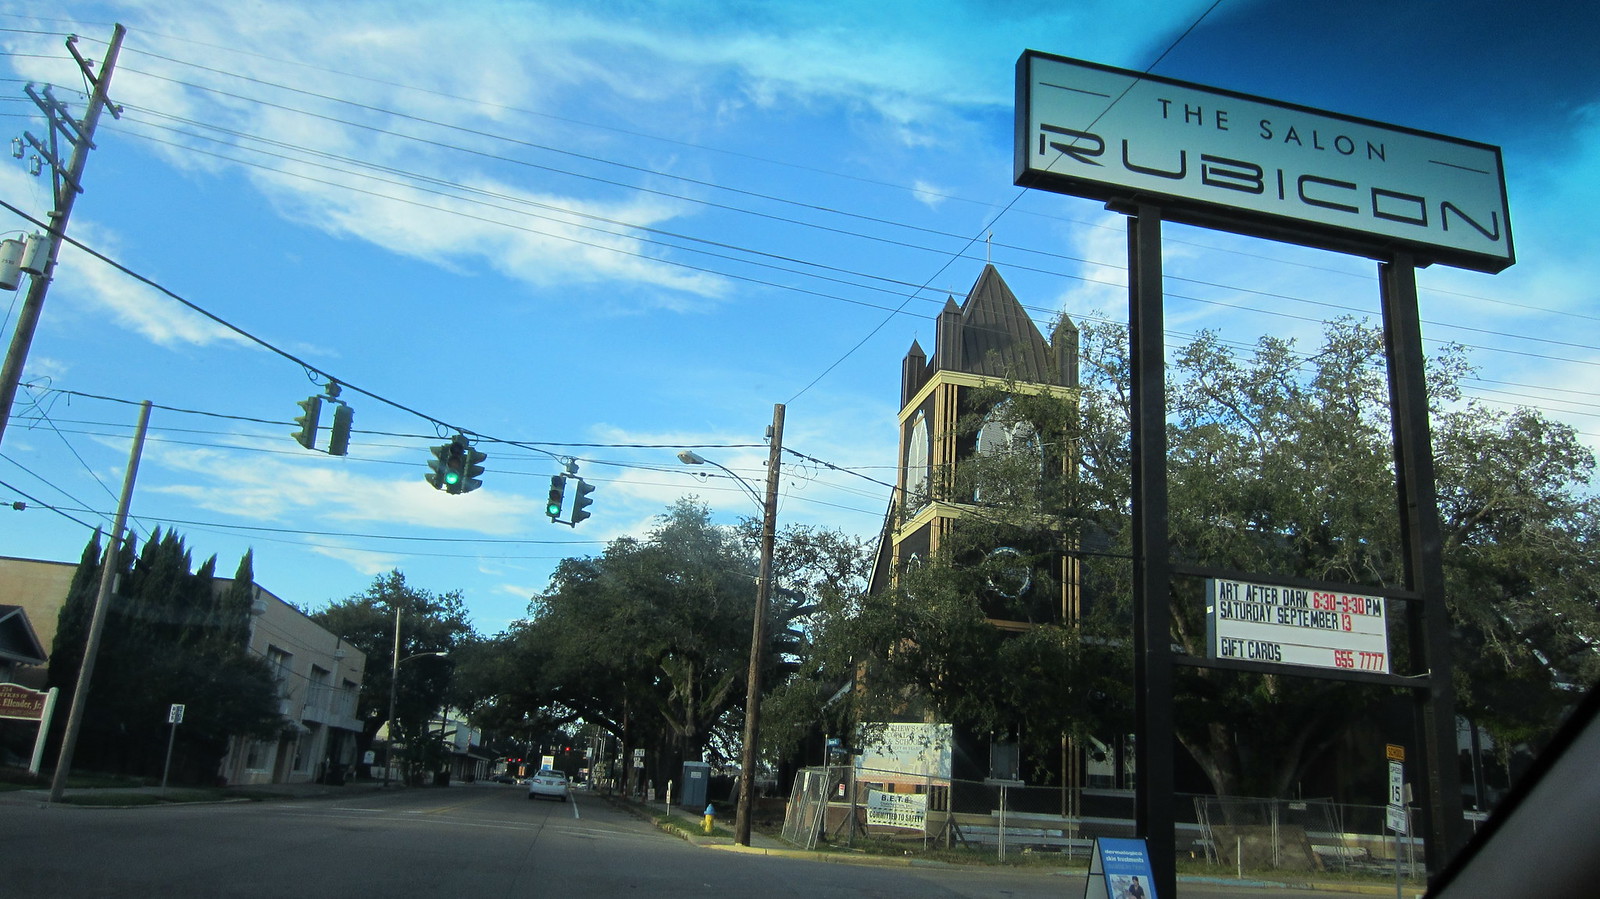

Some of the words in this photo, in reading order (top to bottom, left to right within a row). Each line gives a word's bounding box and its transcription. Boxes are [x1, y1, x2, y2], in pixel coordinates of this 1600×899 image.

[1157, 98, 1230, 131] THE
[1259, 118, 1386, 163] SALON
[1038, 122, 1501, 242] RUBICON
[1219, 581, 1240, 601] ART
[1245, 584, 1278, 605] AFTER
[1282, 589, 1309, 608] DARK
[1219, 601, 1272, 623] SATURDAY
[1277, 607, 1339, 630] SEPTEMBER
[1341, 613, 1352, 631] 13
[1221, 638, 1244, 658] GIFT
[1247, 641, 1282, 662] CARDS
[1334, 650, 1354, 668] 655
[1359, 652, 1385, 671] 7777
[1391, 785, 1401, 802] 15
[898, 813, 905, 821] TO
[906, 814, 924, 823] SAFETY
